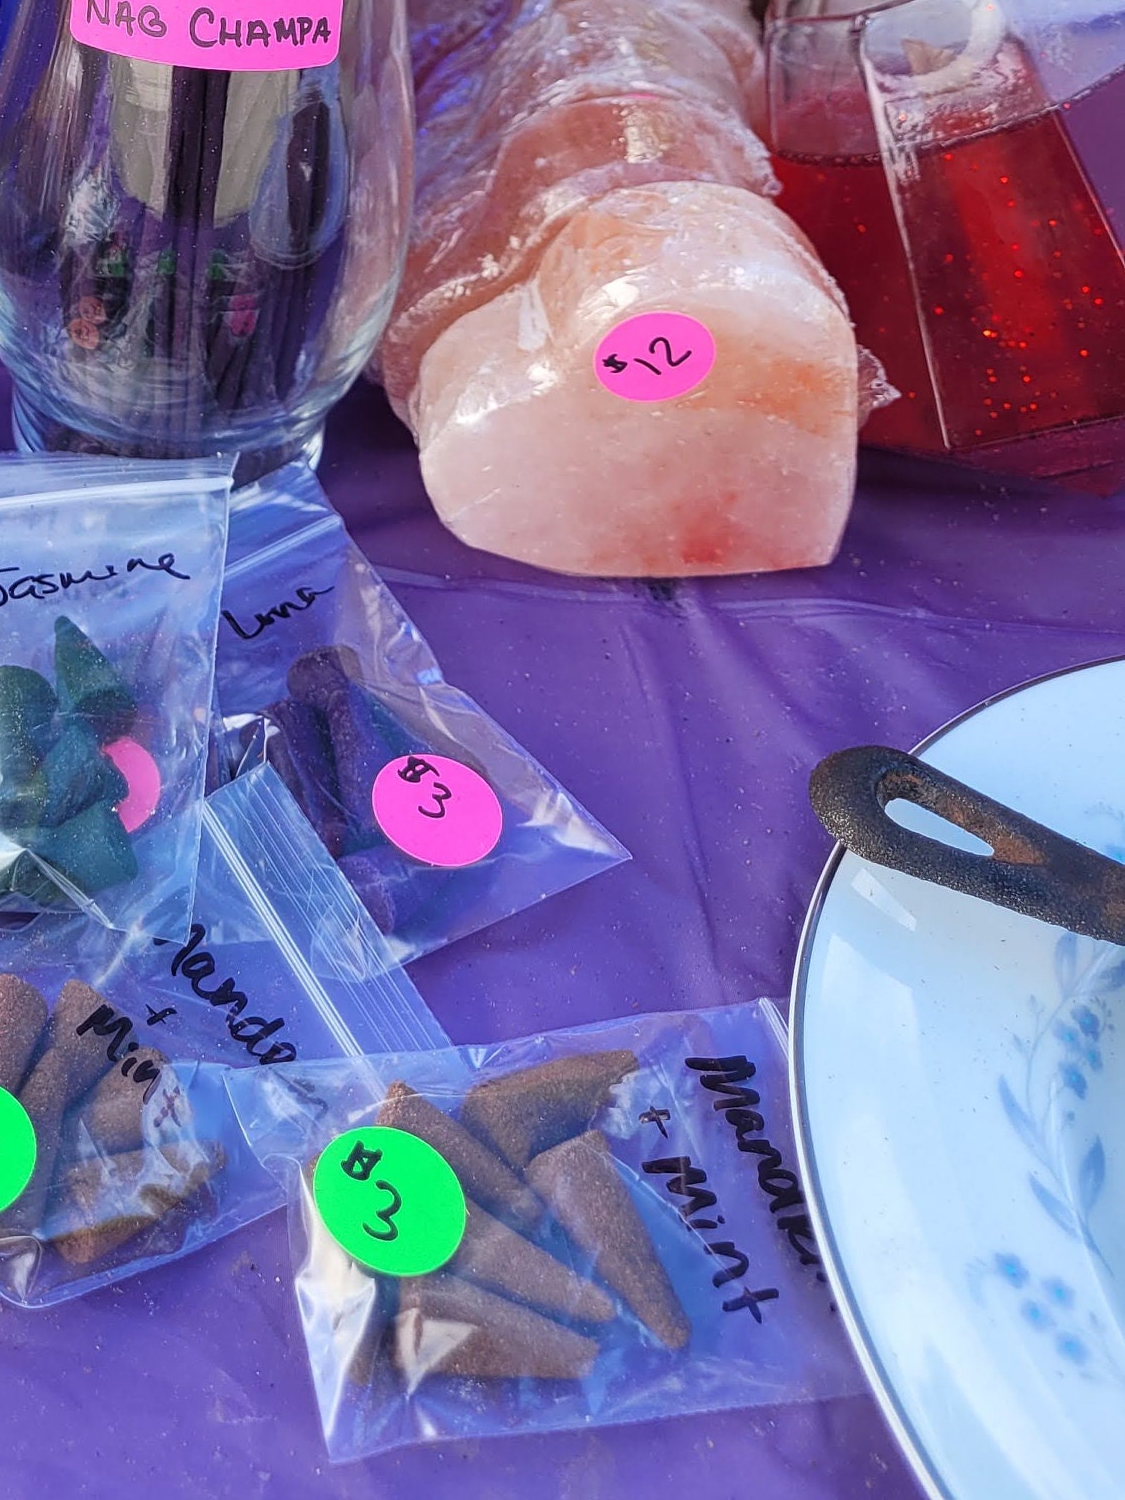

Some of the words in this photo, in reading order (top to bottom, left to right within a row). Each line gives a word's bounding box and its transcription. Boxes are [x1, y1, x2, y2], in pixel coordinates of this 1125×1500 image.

[188, 7, 332, 48] CHAMPA
[601, 336, 693, 376] $12
[641, 1155, 780, 1325] Mint
